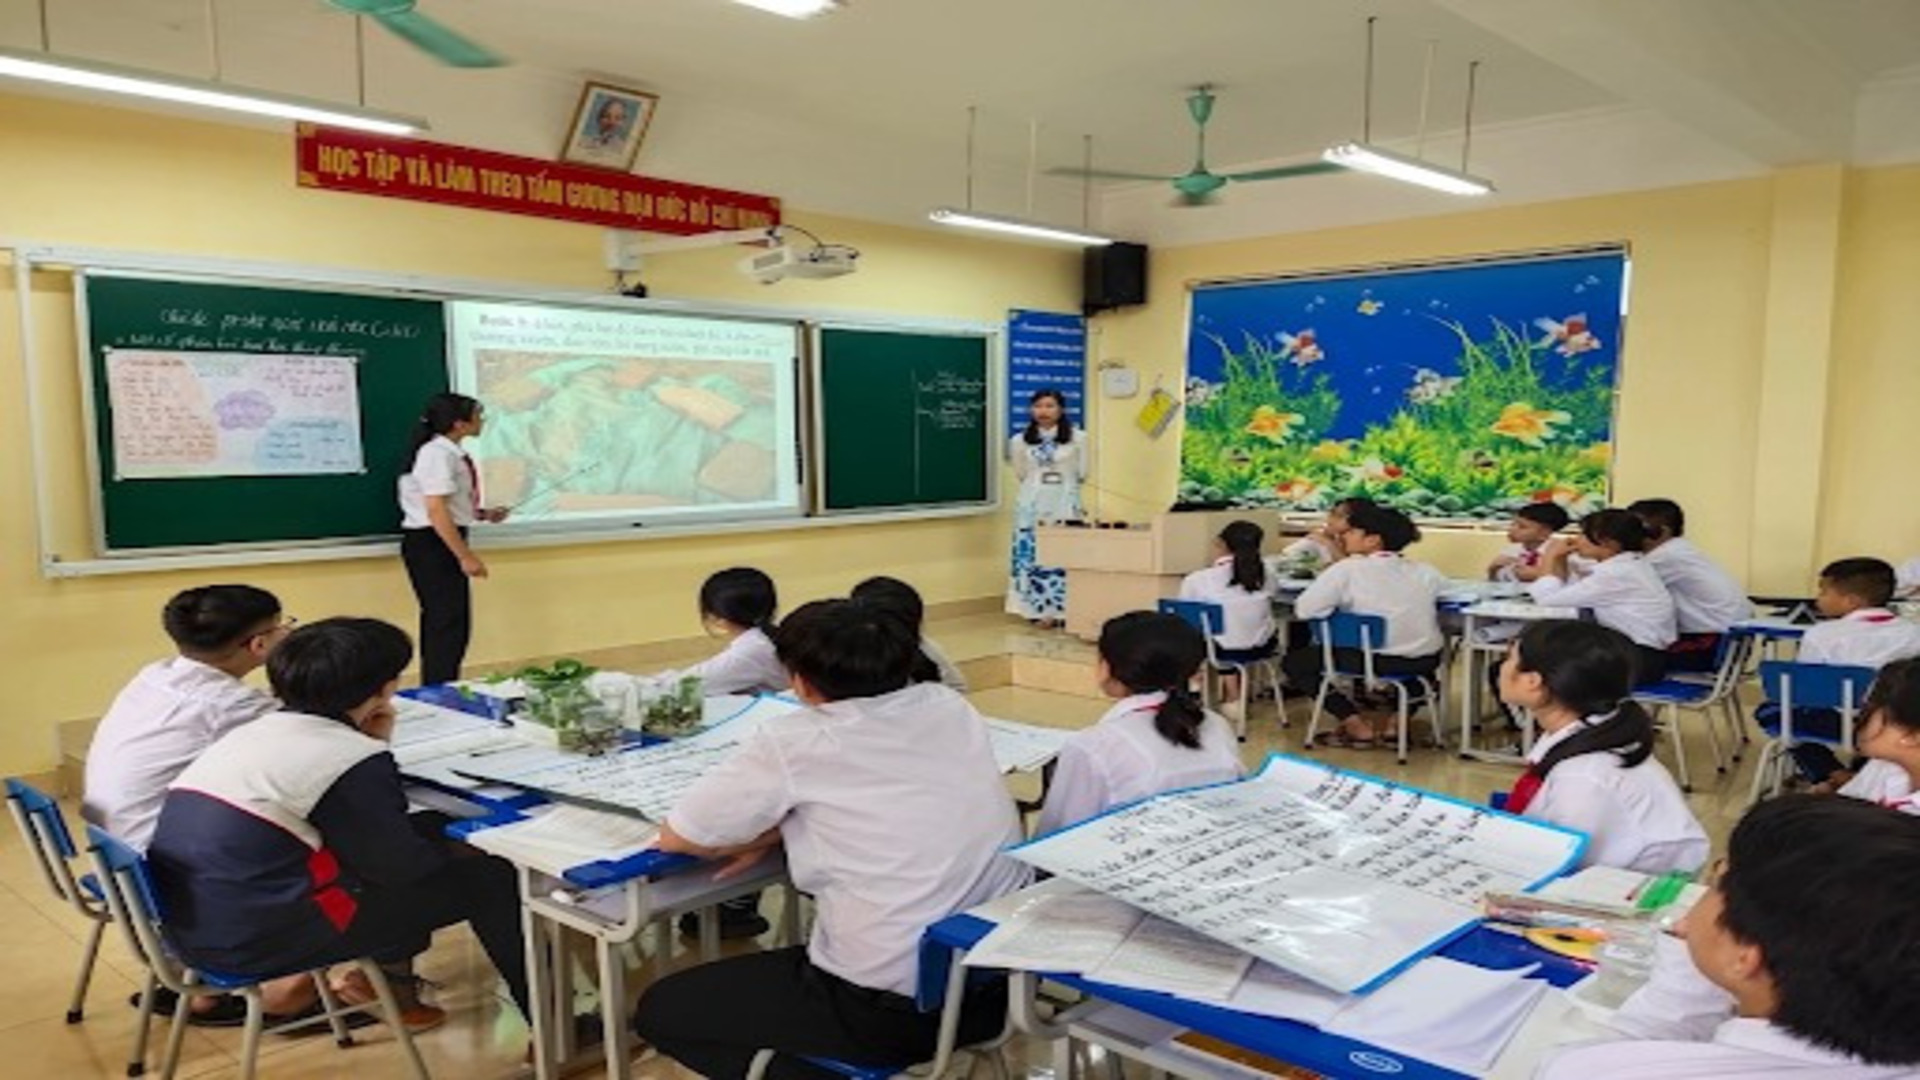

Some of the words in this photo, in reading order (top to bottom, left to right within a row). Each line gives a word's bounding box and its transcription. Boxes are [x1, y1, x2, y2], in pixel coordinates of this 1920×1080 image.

[318, 144, 360, 181] HỌC
[364, 148, 400, 187] TẬP
[405, 154, 433, 187] VÀ
[434, 158, 476, 193] LÀM
[480, 168, 522, 199] THEO
